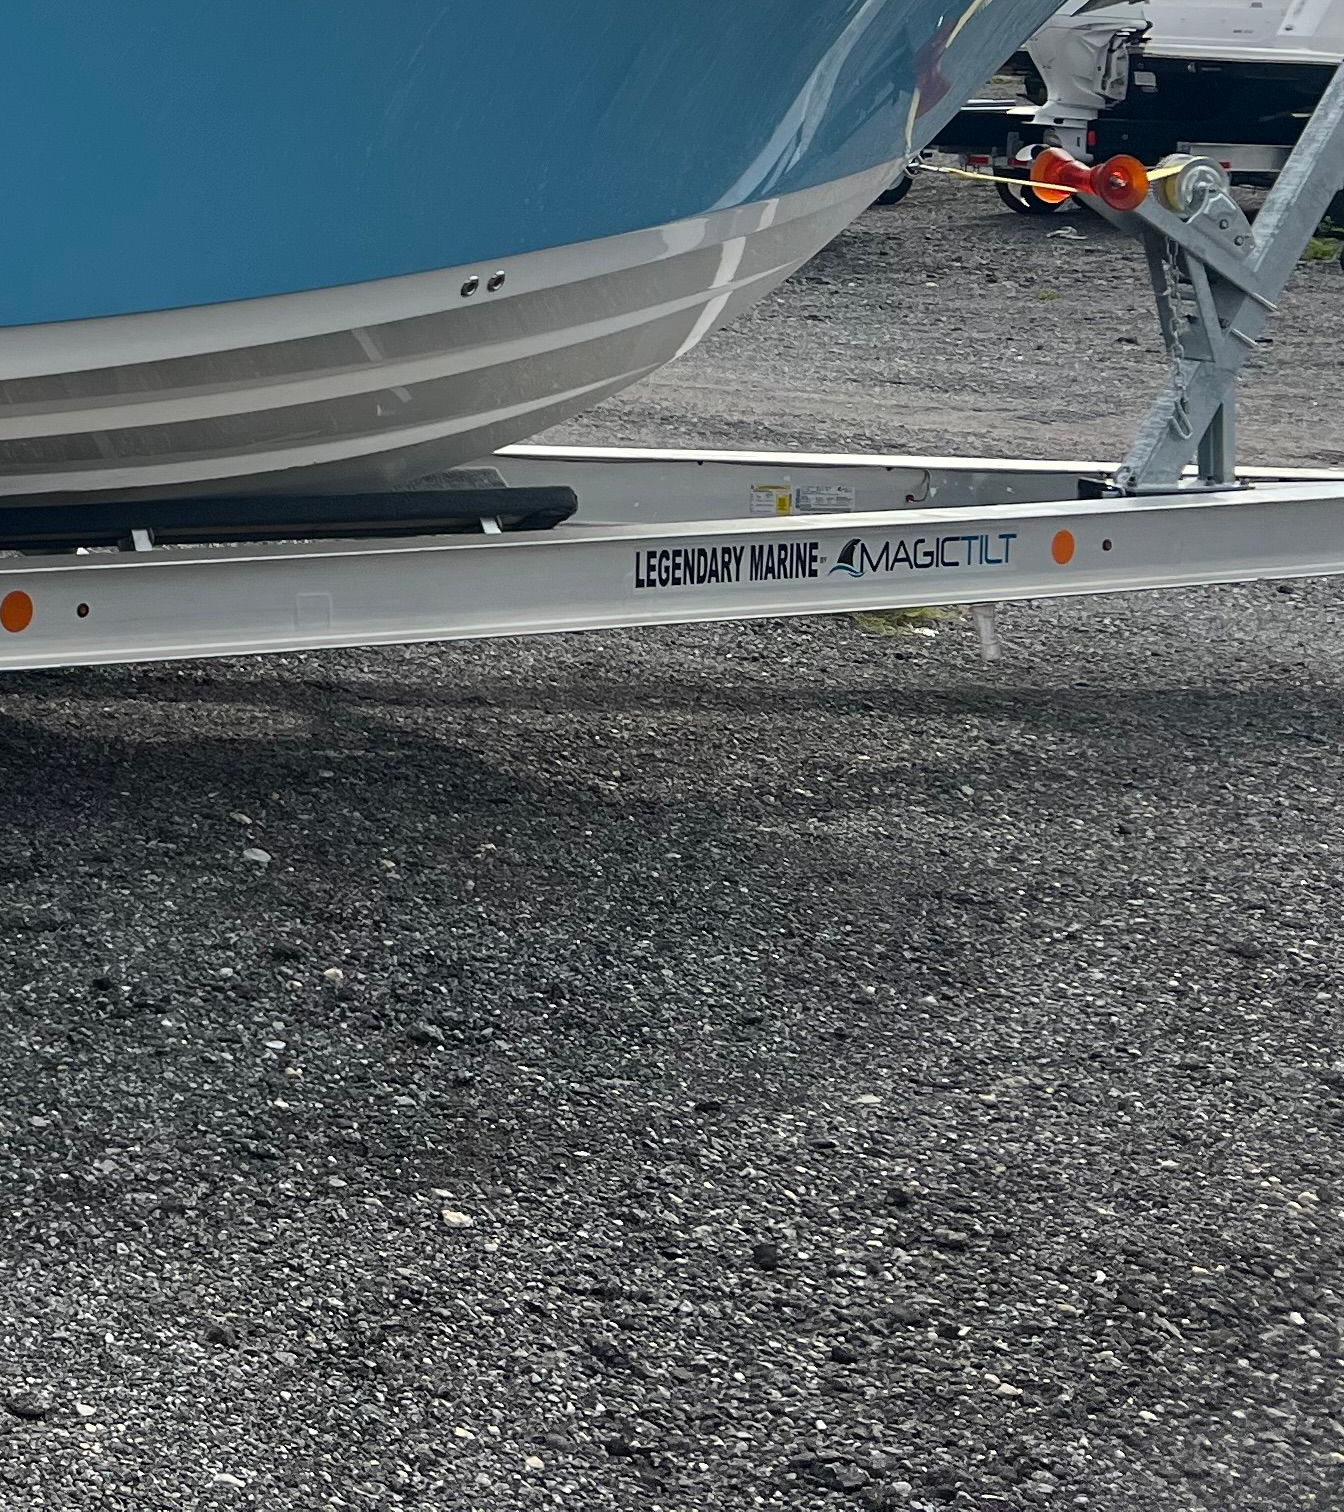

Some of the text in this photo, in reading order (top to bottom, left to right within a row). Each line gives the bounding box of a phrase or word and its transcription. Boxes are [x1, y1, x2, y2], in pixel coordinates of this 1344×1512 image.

[635, 545, 745, 588] LEGENDARY
[749, 541, 819, 581] MARINE
[861, 533, 1017, 573] MAGICTILT
